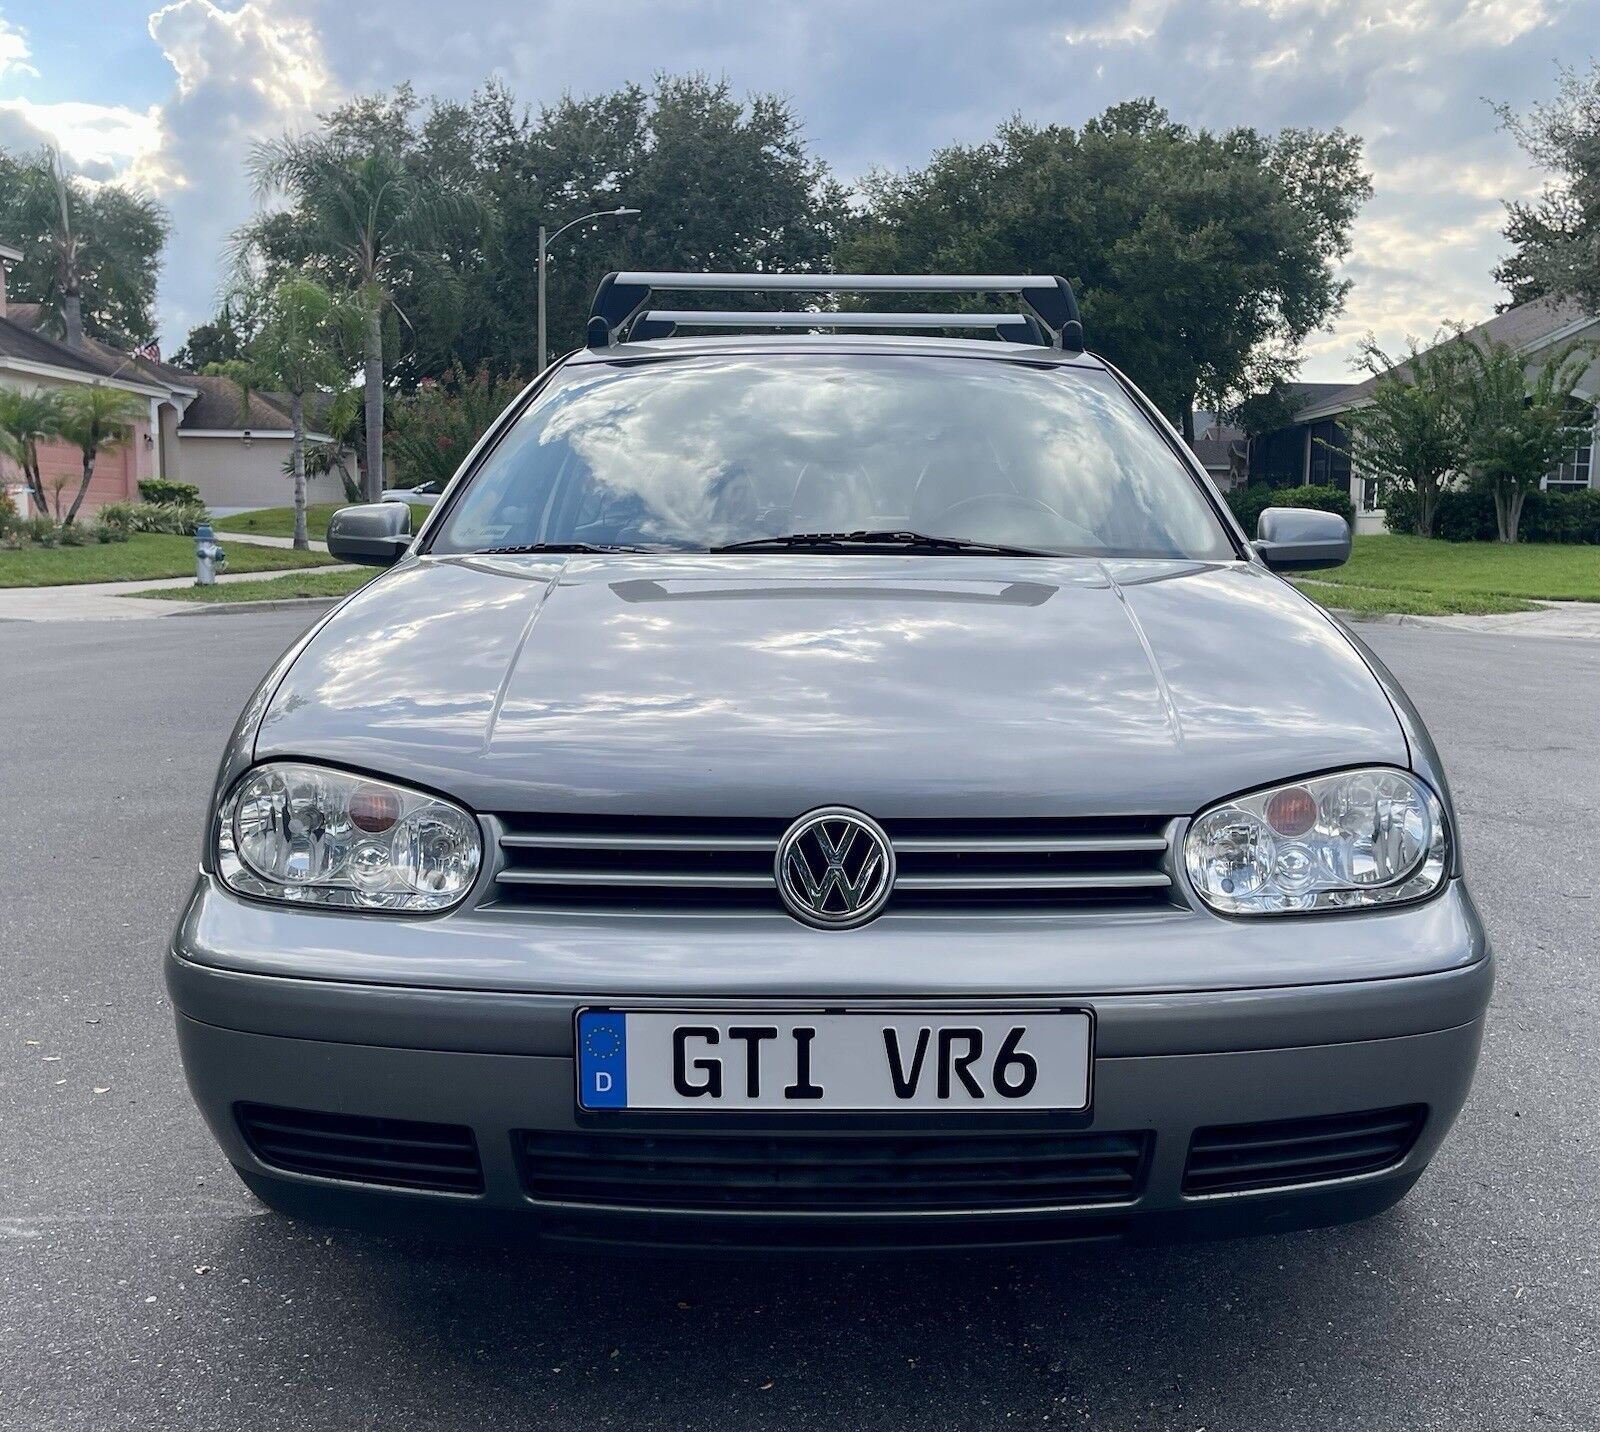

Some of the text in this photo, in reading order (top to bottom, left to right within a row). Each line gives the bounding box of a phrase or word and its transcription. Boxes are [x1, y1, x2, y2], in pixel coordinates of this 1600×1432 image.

[783, 815, 888, 914] VW
[595, 1071, 613, 1092] D
[672, 1026, 1038, 1100] GTI VR6
